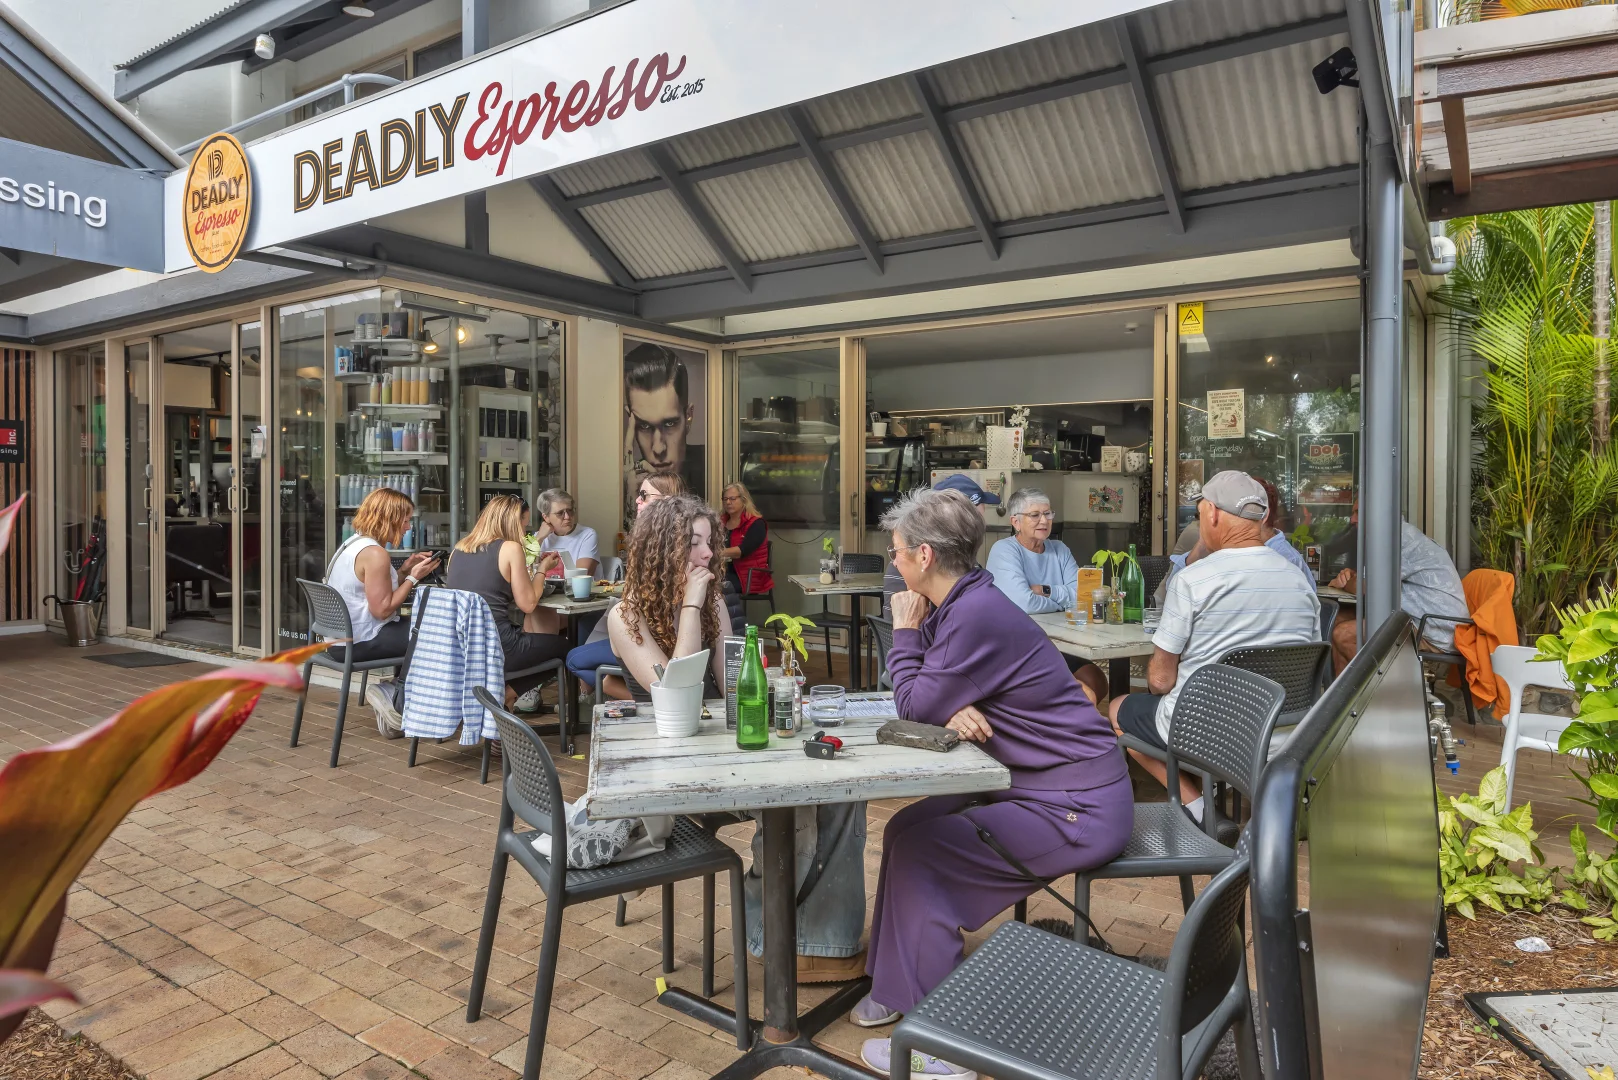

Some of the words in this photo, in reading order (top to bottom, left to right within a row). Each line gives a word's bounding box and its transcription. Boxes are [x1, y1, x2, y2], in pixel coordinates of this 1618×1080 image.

[660, 84, 681, 103] Est.
[681, 78, 705, 97] 2015
[294, 92, 470, 213] DEADLY
[464, 52, 686, 176] Espresso
[0, 177, 106, 228] ssing
[192, 174, 243, 213] DEADLY
[194, 208, 241, 240] Espresso
[7, 429, 16, 445] inc.
[278, 627, 290, 638] Like
[291, 631, 299, 639] us
[299, 633, 308, 641] on
